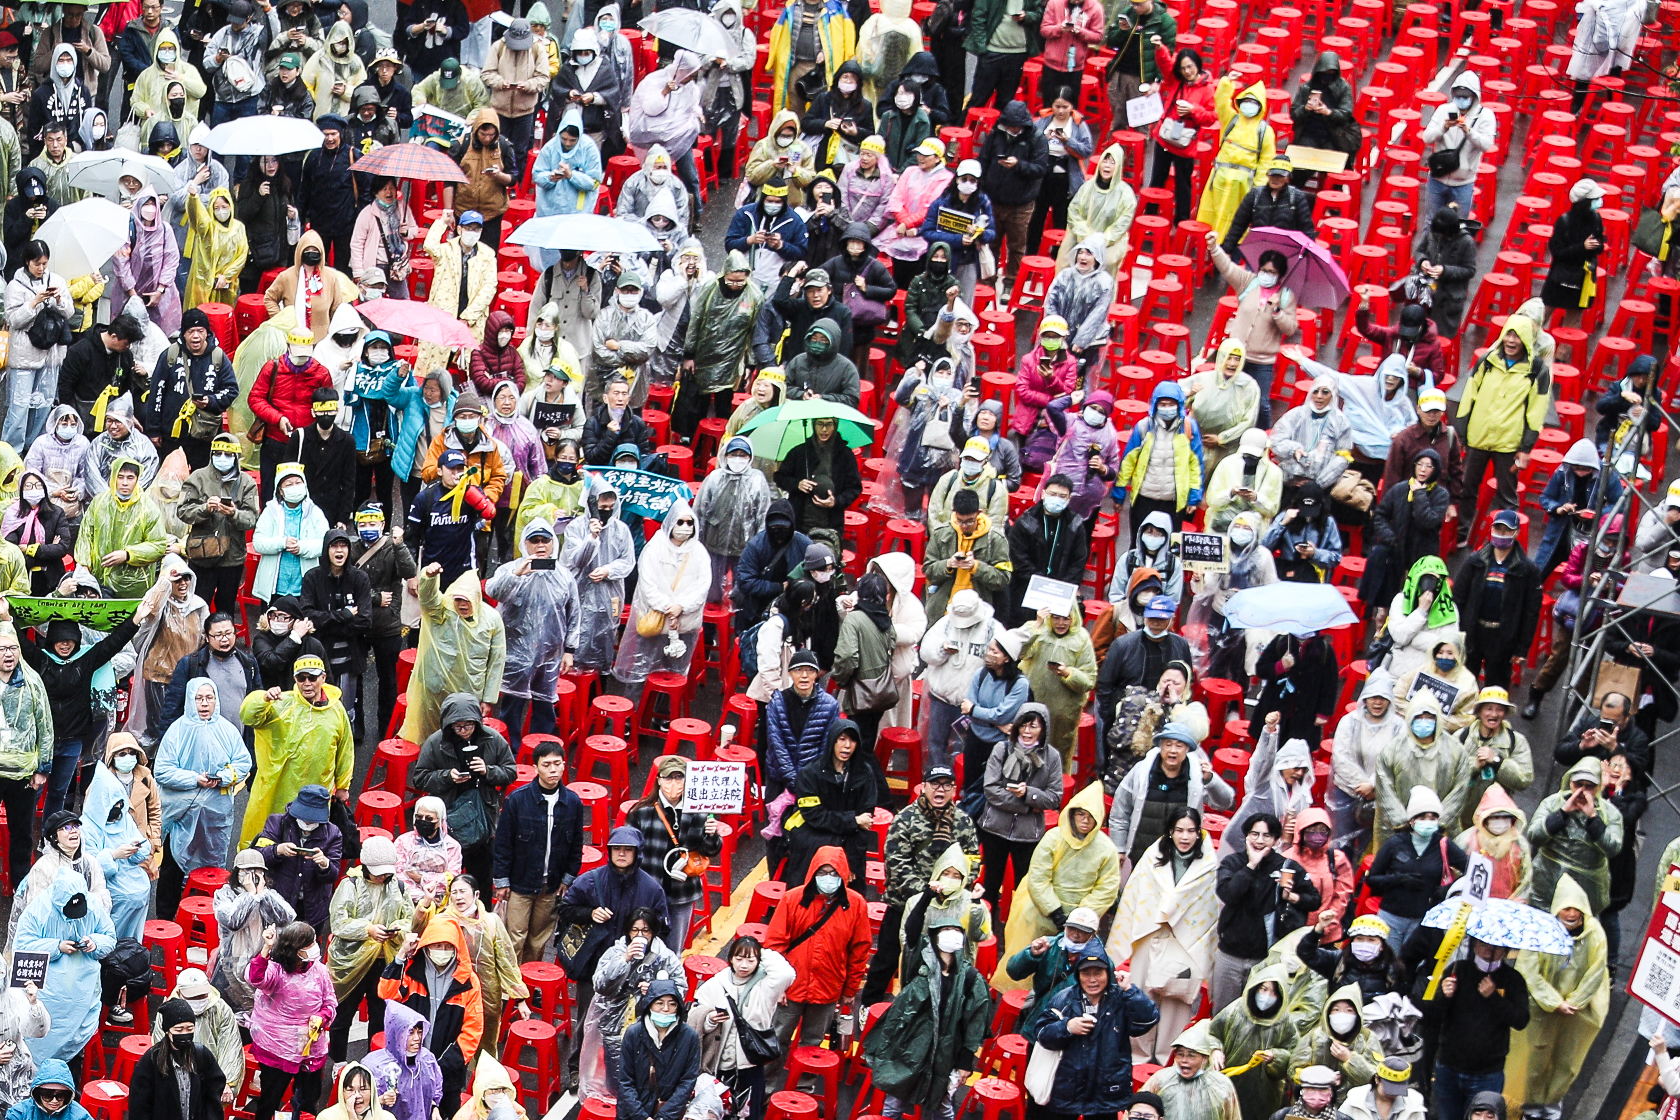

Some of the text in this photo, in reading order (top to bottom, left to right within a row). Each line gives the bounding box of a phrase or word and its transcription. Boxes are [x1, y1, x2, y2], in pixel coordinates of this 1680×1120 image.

[691, 775, 740, 787] 中共代理人
[687, 787, 742, 800] 退出立法院
